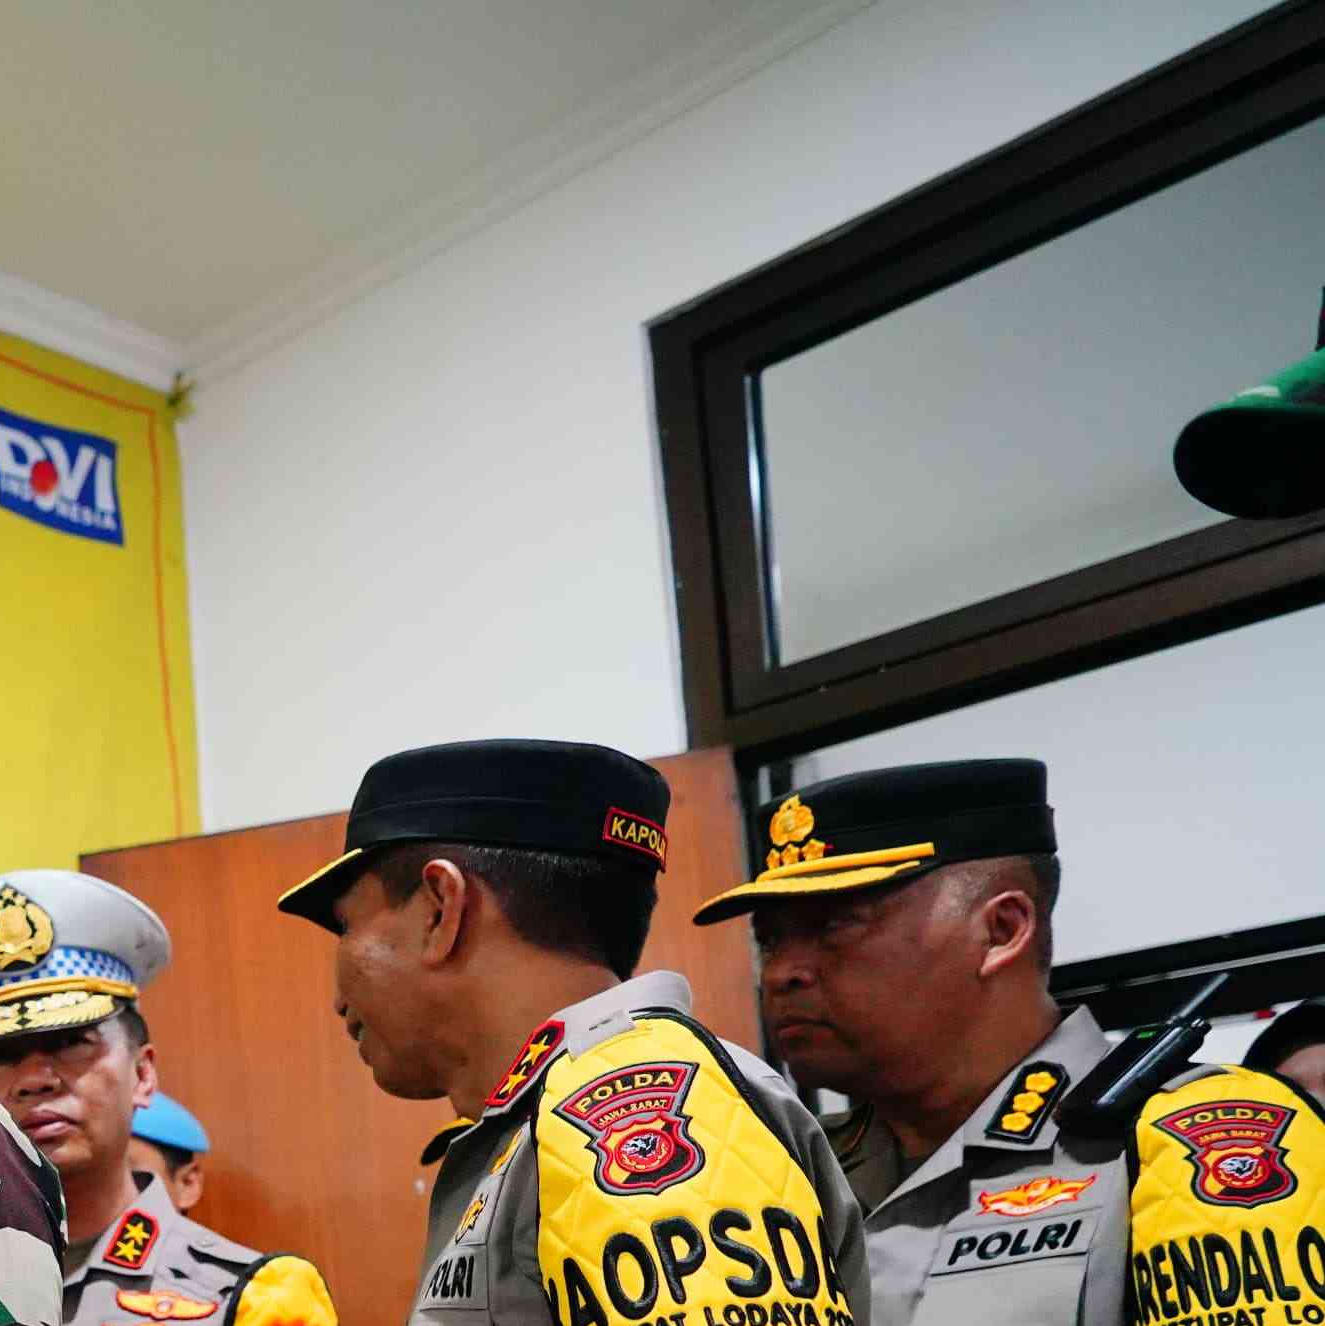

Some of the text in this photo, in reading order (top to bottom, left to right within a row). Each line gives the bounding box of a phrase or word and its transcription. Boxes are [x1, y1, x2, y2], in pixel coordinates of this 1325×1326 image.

[574, 1071, 674, 1112] POLDA
[599, 1099, 668, 1126] JAWA BARAT
[1174, 1108, 1274, 1130] POLDA
[947, 1219, 1082, 1266] POLRI
